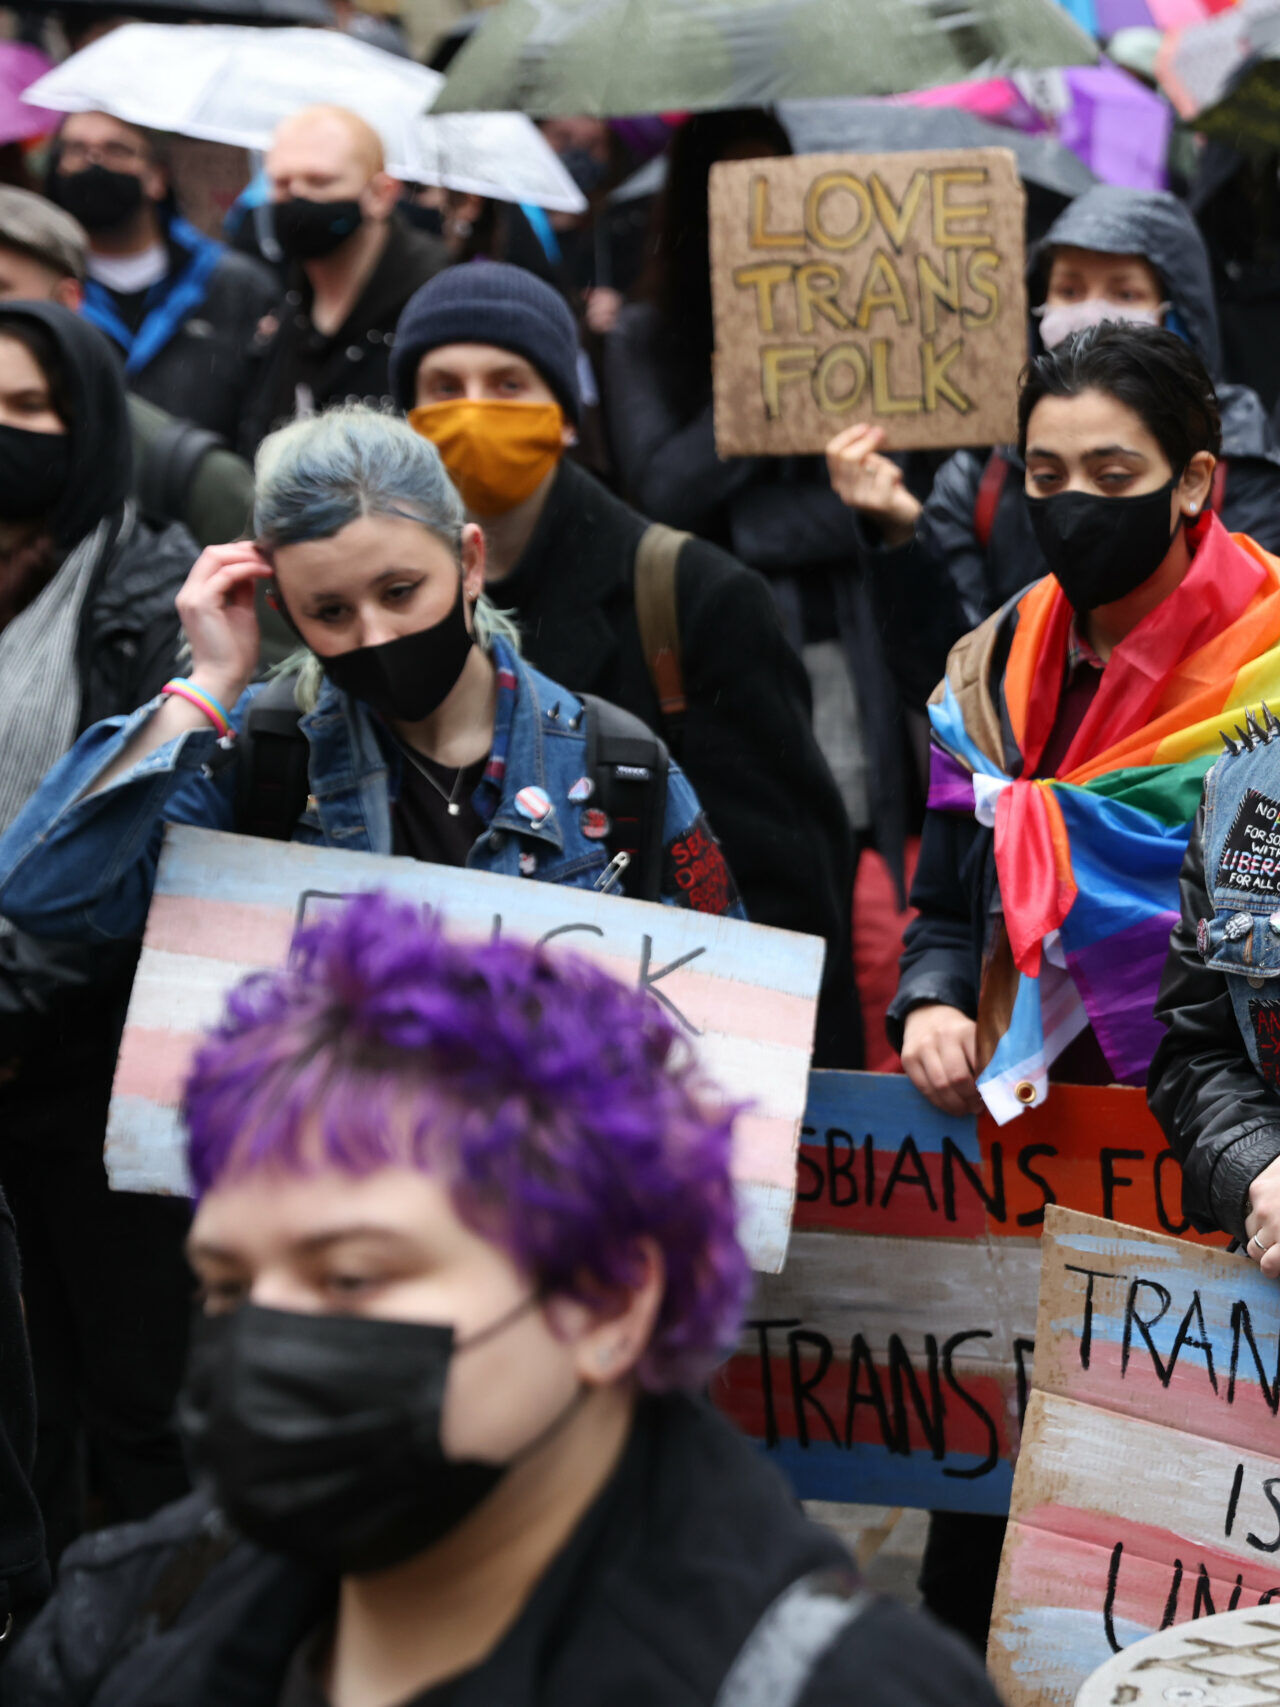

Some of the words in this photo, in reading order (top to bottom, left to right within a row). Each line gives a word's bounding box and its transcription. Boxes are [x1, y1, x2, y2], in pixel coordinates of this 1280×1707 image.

[749, 167, 993, 254] LOVE
[732, 247, 1001, 340] TRANS
[759, 337, 978, 420] FOLK
[1244, 825, 1266, 840] FOR
[1255, 802, 1277, 820] NO
[1229, 872, 1250, 886] FOR
[1253, 880, 1274, 890] ALL
[743, 1318, 998, 1479] TRANS
